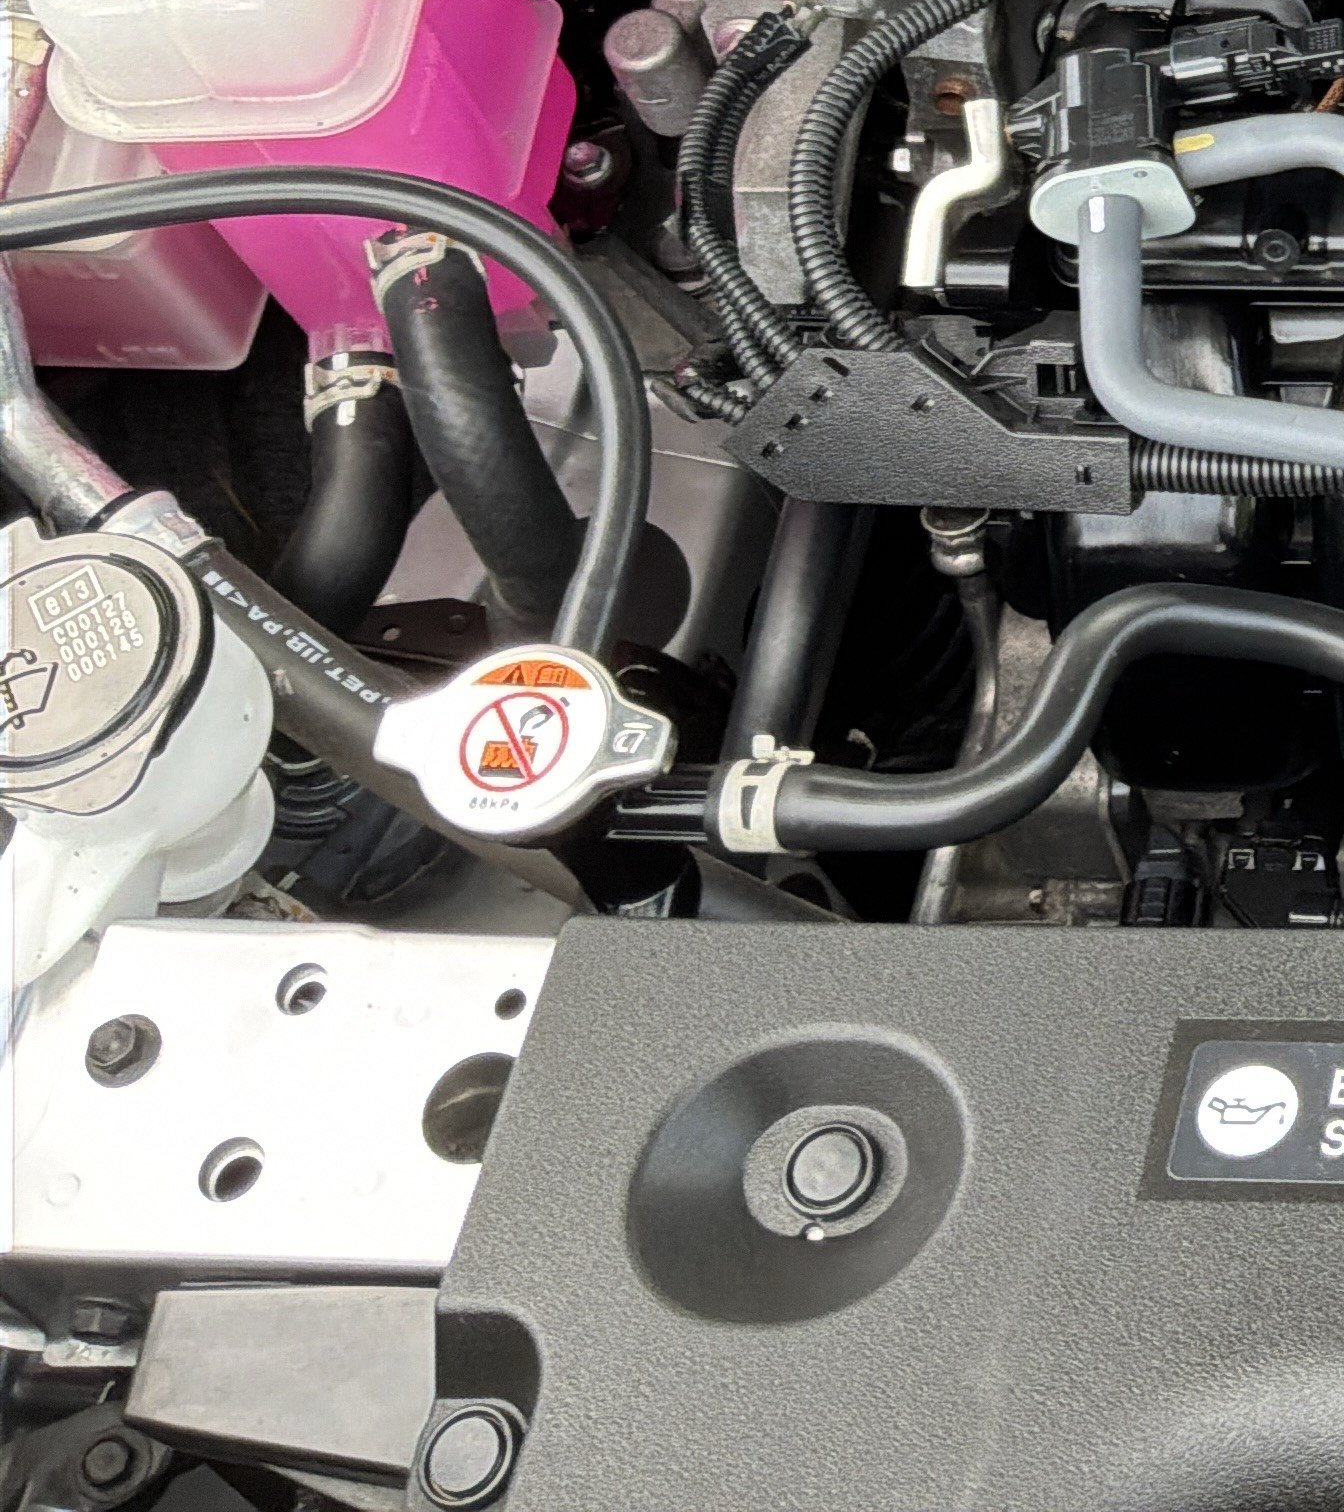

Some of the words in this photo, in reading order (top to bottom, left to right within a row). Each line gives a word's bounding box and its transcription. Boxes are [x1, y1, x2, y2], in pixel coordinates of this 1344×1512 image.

[52, 591, 126, 646] C00127
[59, 610, 136, 664] 000128
[67, 628, 144, 682] 000145
